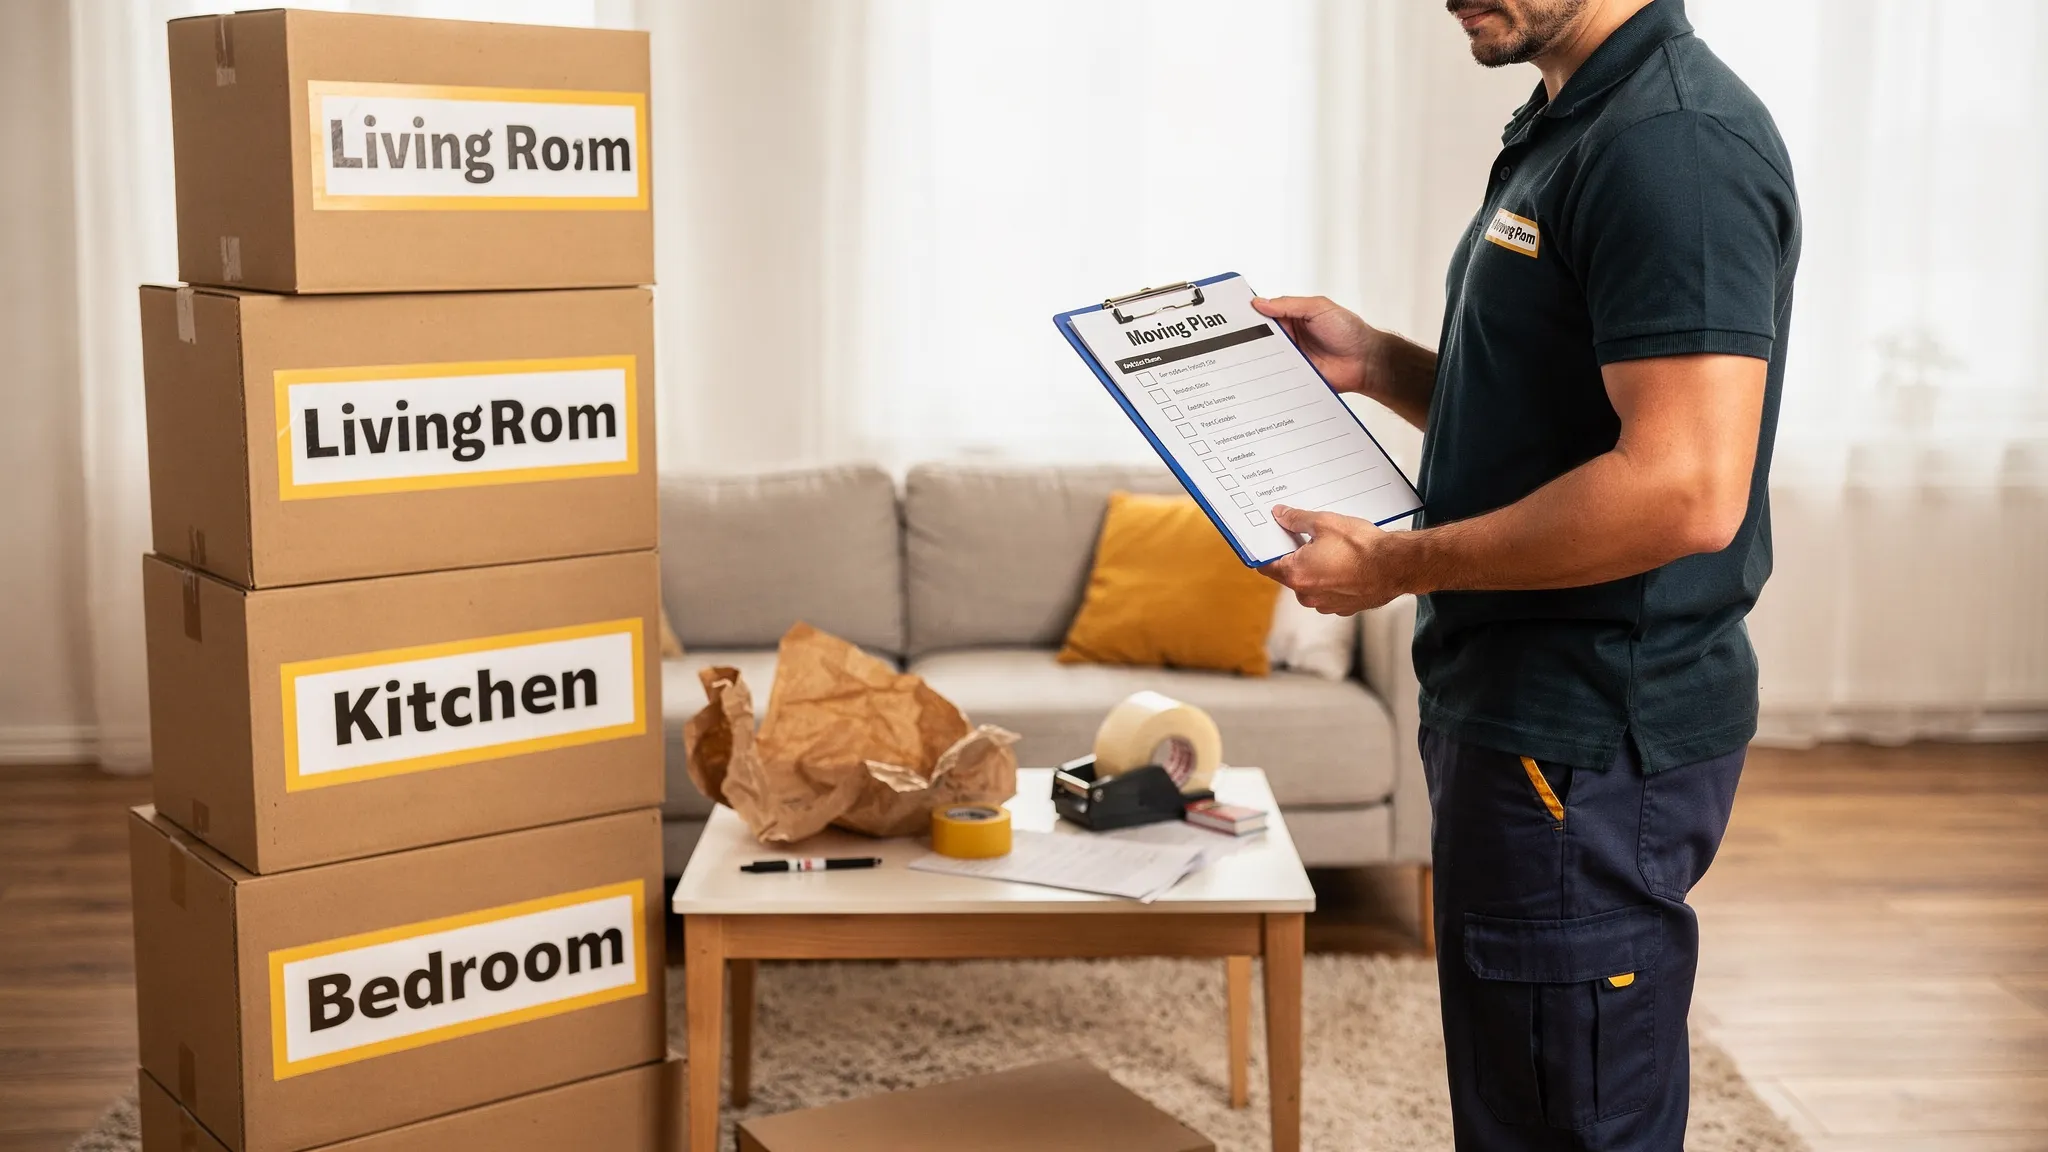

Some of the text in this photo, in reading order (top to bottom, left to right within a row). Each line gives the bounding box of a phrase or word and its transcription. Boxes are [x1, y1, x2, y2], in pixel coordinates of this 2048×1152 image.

[330, 115, 494, 184] Living
[1125, 313, 1228, 347] Moving Plan
[334, 667, 598, 746] Kitchen
[308, 927, 625, 1033] Bedroom
